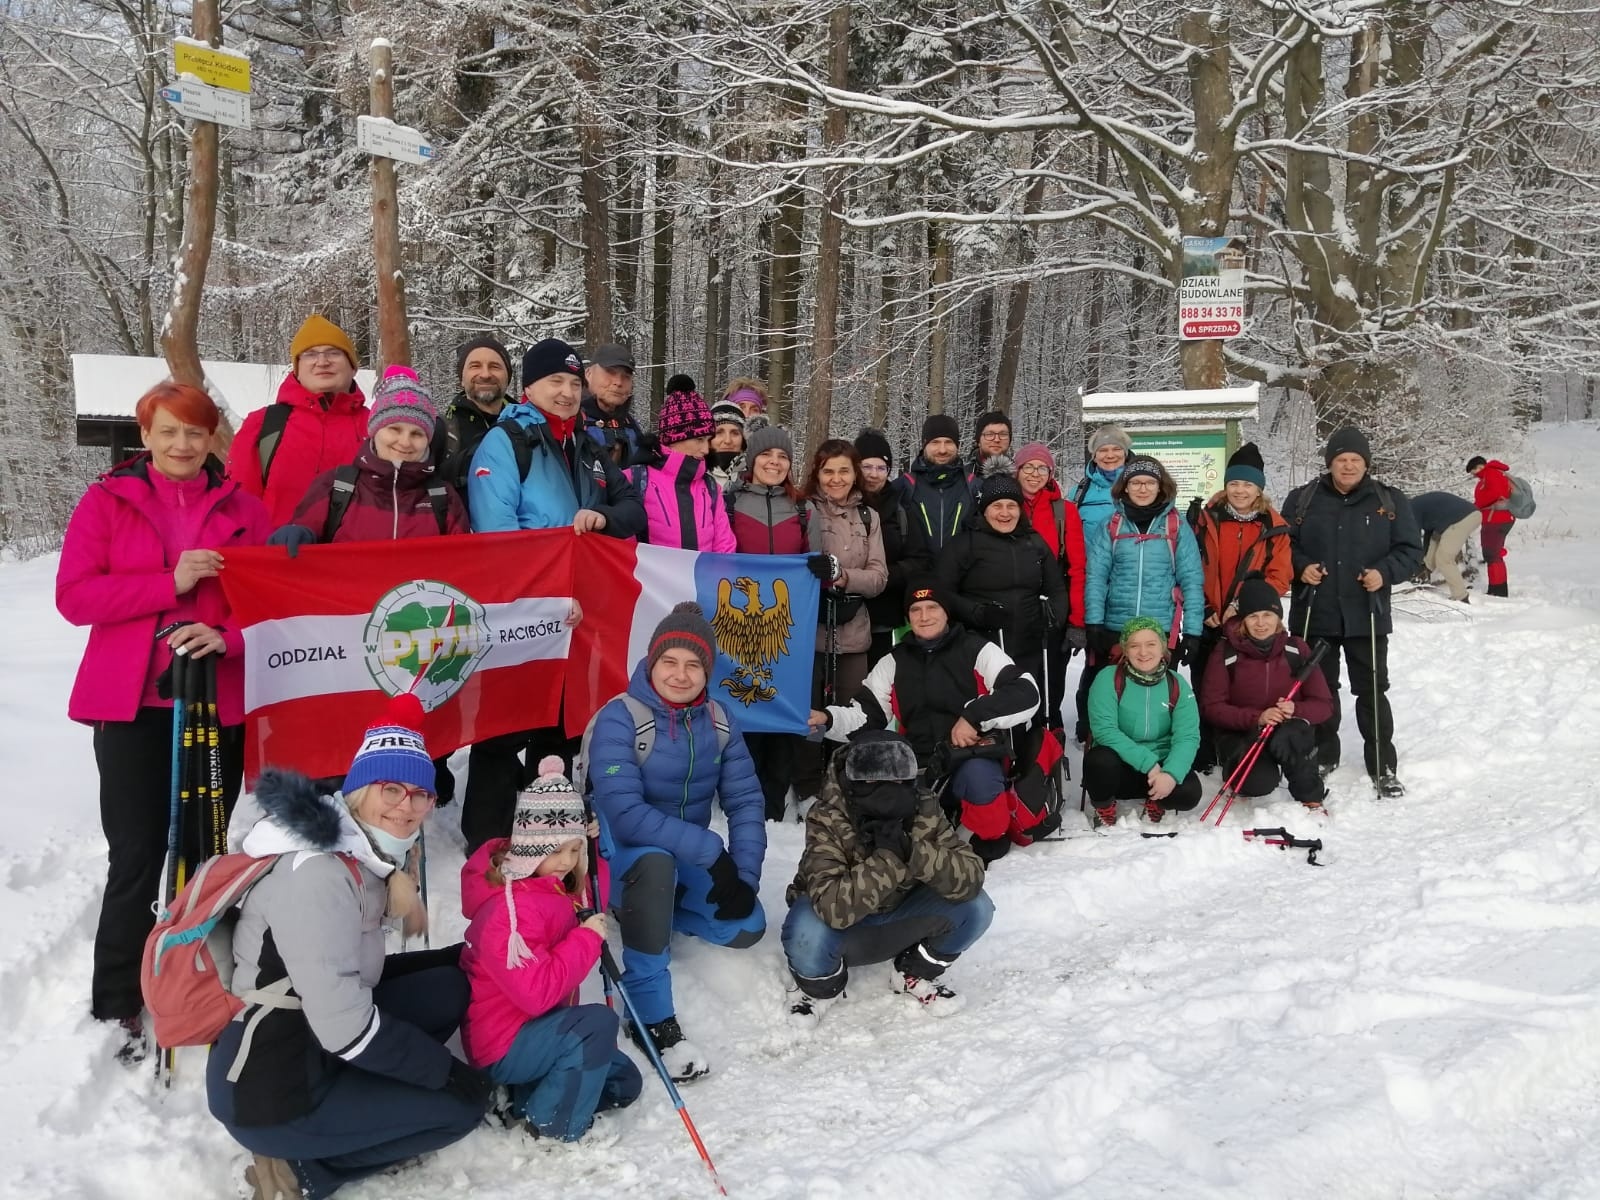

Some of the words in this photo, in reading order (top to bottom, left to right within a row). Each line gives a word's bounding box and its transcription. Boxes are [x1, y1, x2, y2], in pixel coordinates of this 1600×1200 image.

[1182, 278, 1220, 288] DZIAŁKI
[1181, 289, 1243, 299] BUDOWLANE
[1181, 308, 1199, 318] 888
[1201, 307, 1212, 318] 34
[1215, 307, 1227, 317] 33
[1230, 306, 1242, 317] 78
[1186, 326, 1197, 334] NA
[1198, 324, 1238, 333] SPRZEDAŻ
[416, 583, 426, 591] N
[500, 619, 562, 643] RACIBÓRZ
[366, 645, 377, 653] W
[268, 645, 347, 669] ODDZIAŁ
[209, 748, 218, 789] VIKING
